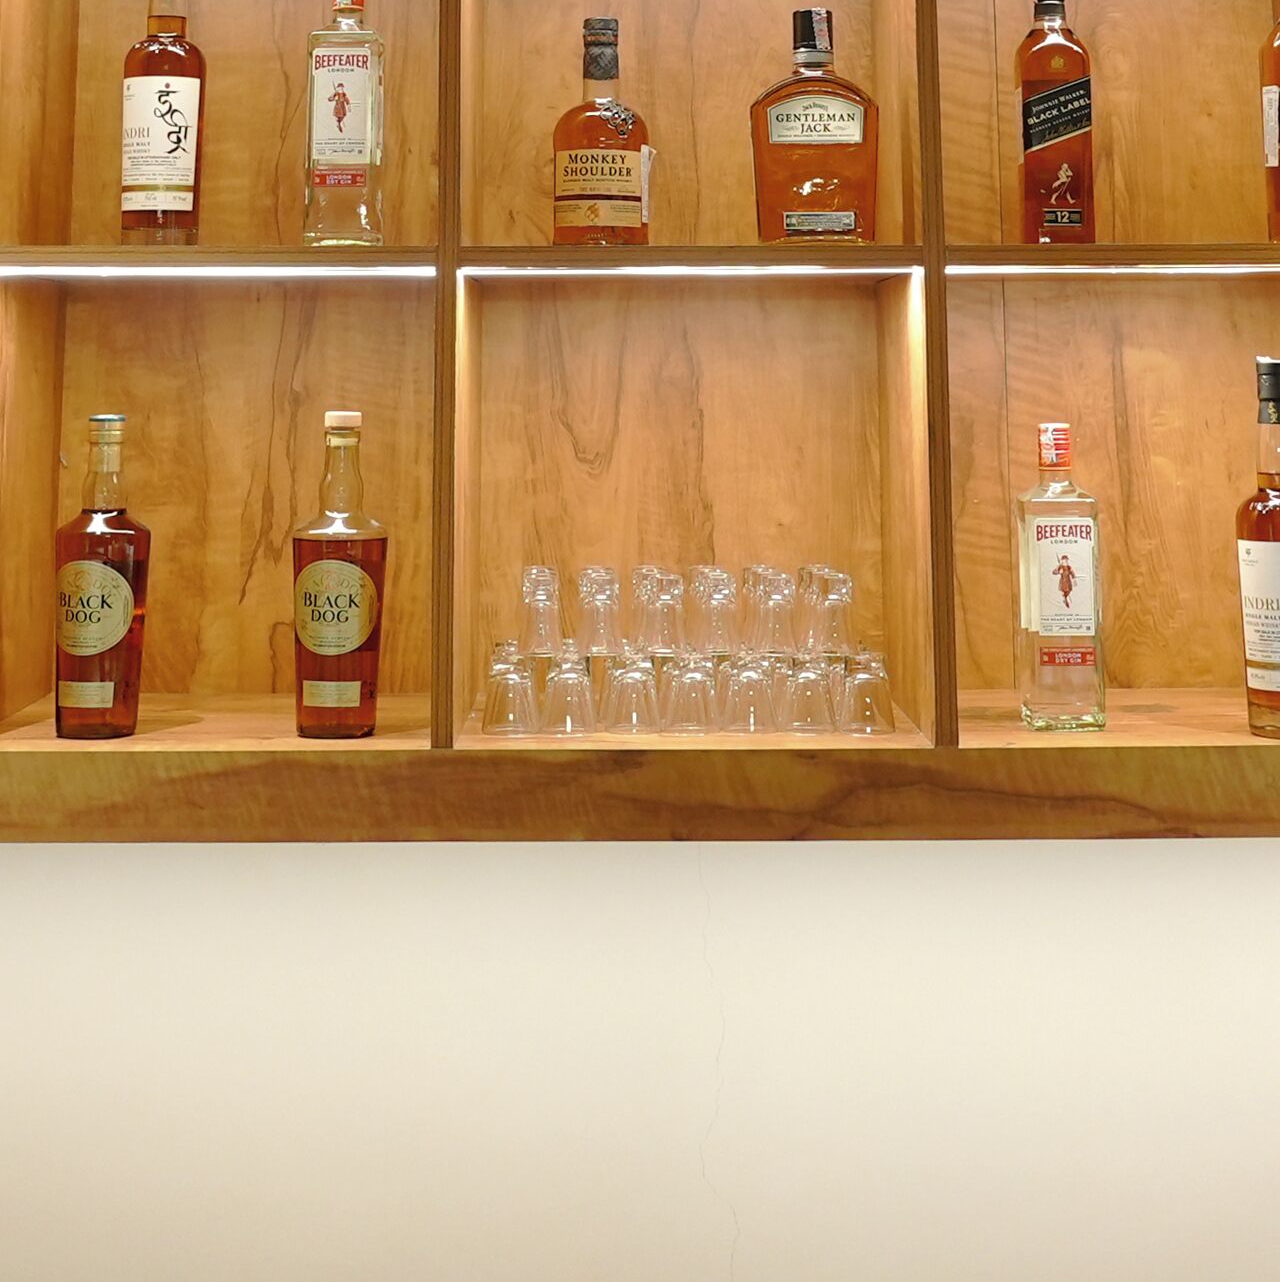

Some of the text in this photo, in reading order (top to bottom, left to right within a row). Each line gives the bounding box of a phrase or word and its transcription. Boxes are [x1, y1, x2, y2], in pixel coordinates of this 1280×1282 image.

[314, 54, 369, 71] BEEFEATER
[775, 113, 856, 123] GENTLEMAN
[1027, 96, 1091, 125] BLACK LABEL
[800, 123, 832, 135] JACK
[568, 153, 627, 165] MONKEY
[562, 165, 632, 178] SHOULDER
[1056, 211, 1070, 223] 12
[1036, 524, 1092, 541] BEEFEATER
[59, 591, 113, 610] BLACK
[303, 591, 361, 609] BLACK
[64, 609, 101, 624] DOG
[311, 608, 350, 624] DOG
